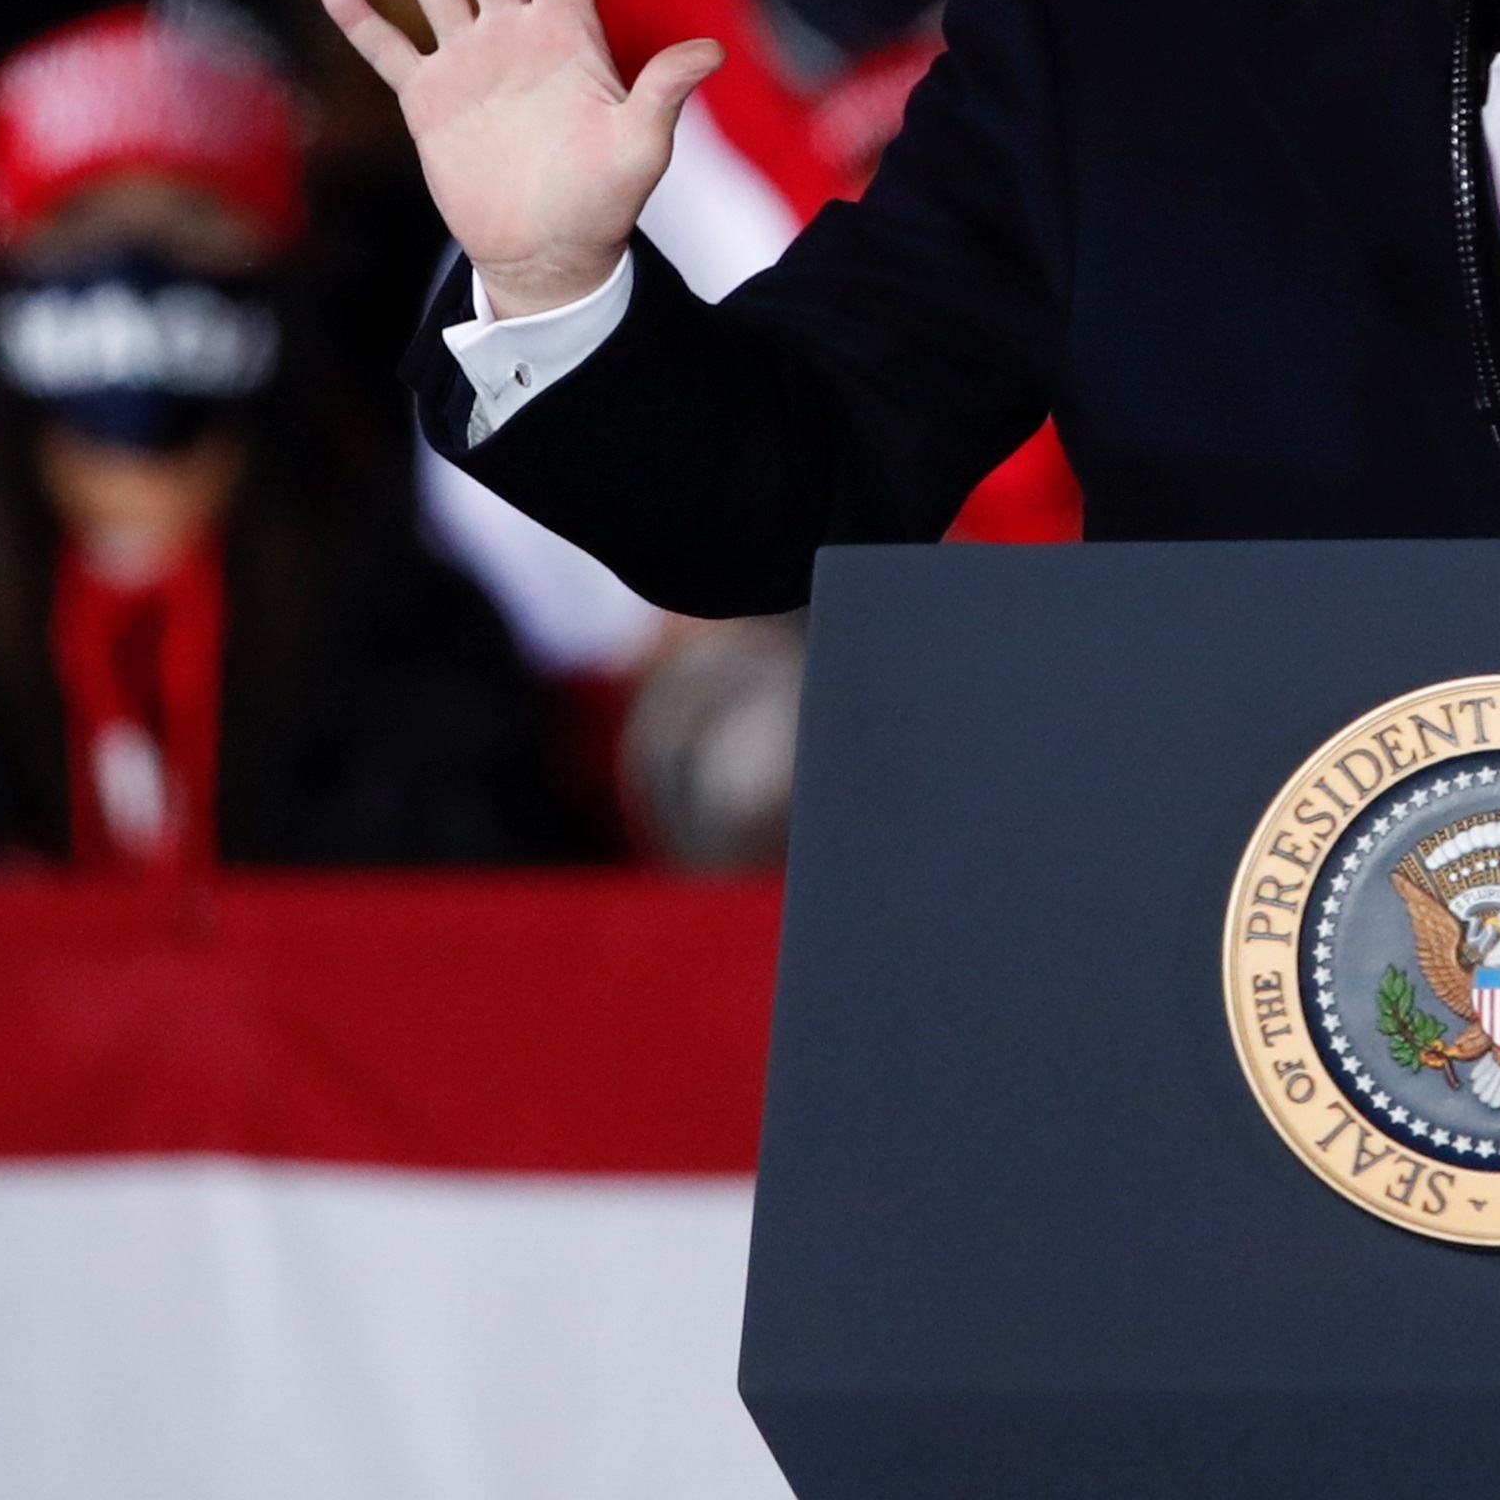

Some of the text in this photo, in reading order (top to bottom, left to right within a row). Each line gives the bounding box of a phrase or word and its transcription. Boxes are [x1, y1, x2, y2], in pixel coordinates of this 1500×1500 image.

[1245, 696, 1496, 947] PRESIDENT
[1252, 970, 1292, 1047] THE
[1274, 1058, 1315, 1105] OF
[1316, 1102, 1455, 1215] SEAL
